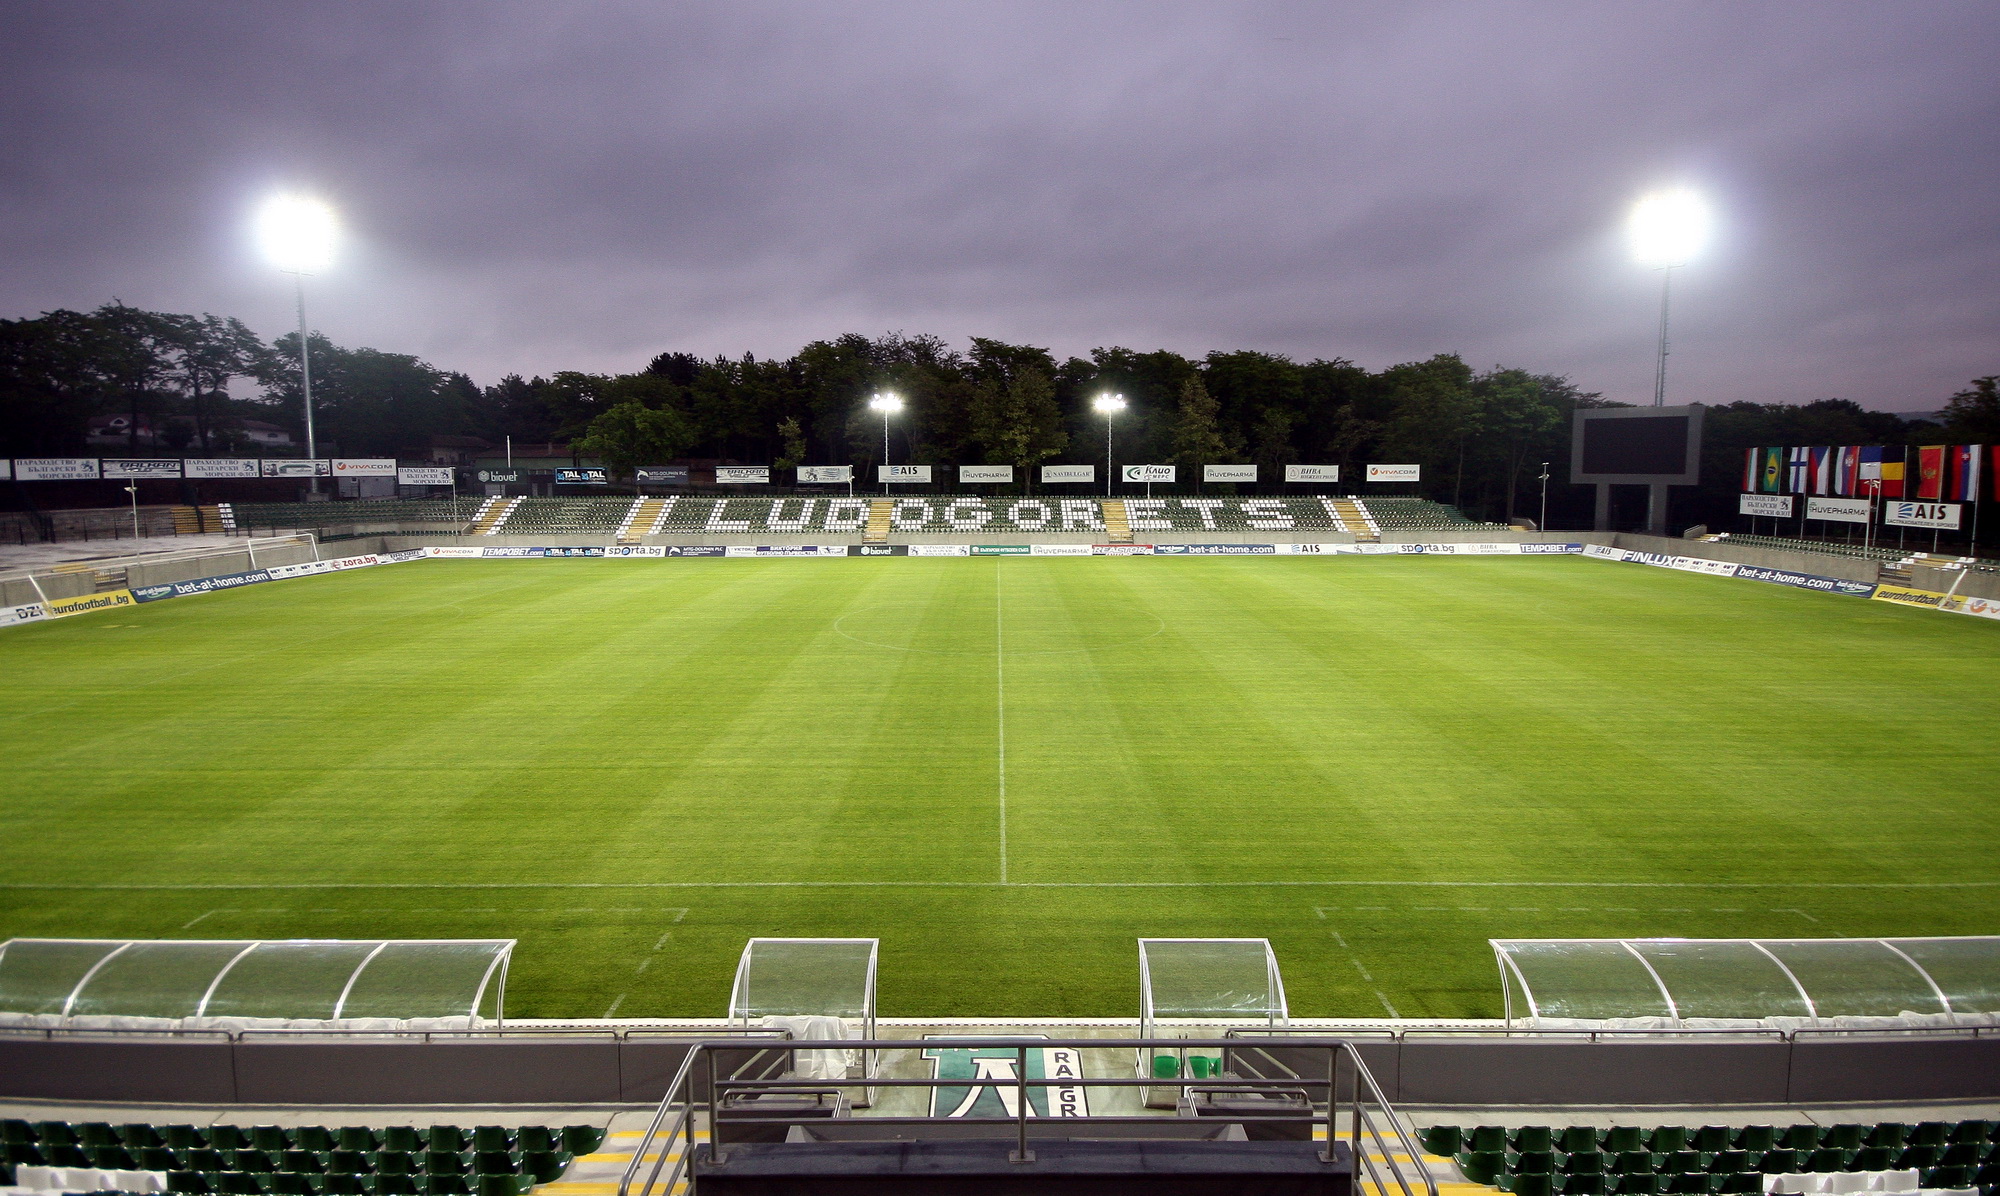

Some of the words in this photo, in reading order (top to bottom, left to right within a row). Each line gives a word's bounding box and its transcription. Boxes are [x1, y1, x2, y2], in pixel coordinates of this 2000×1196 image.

[491, 470, 518, 481] biovet
[704, 498, 1296, 530] LUDOGORETS
[1813, 506, 1865, 515] HUVEPHARMA
[1914, 504, 1946, 520] AIS
[608, 546, 661, 556] sporta.bg
[1188, 545, 1274, 553] bet-at-home.com
[1401, 544, 1454, 553] sporta.bg
[1521, 544, 1582, 552] TEMPOBET.com
[343, 556, 377, 567] zora.bg
[1622, 550, 1677, 567] FINLUX
[175, 571, 269, 594] bet-at-home.com
[1738, 567, 1834, 589] bet-at-home.com
